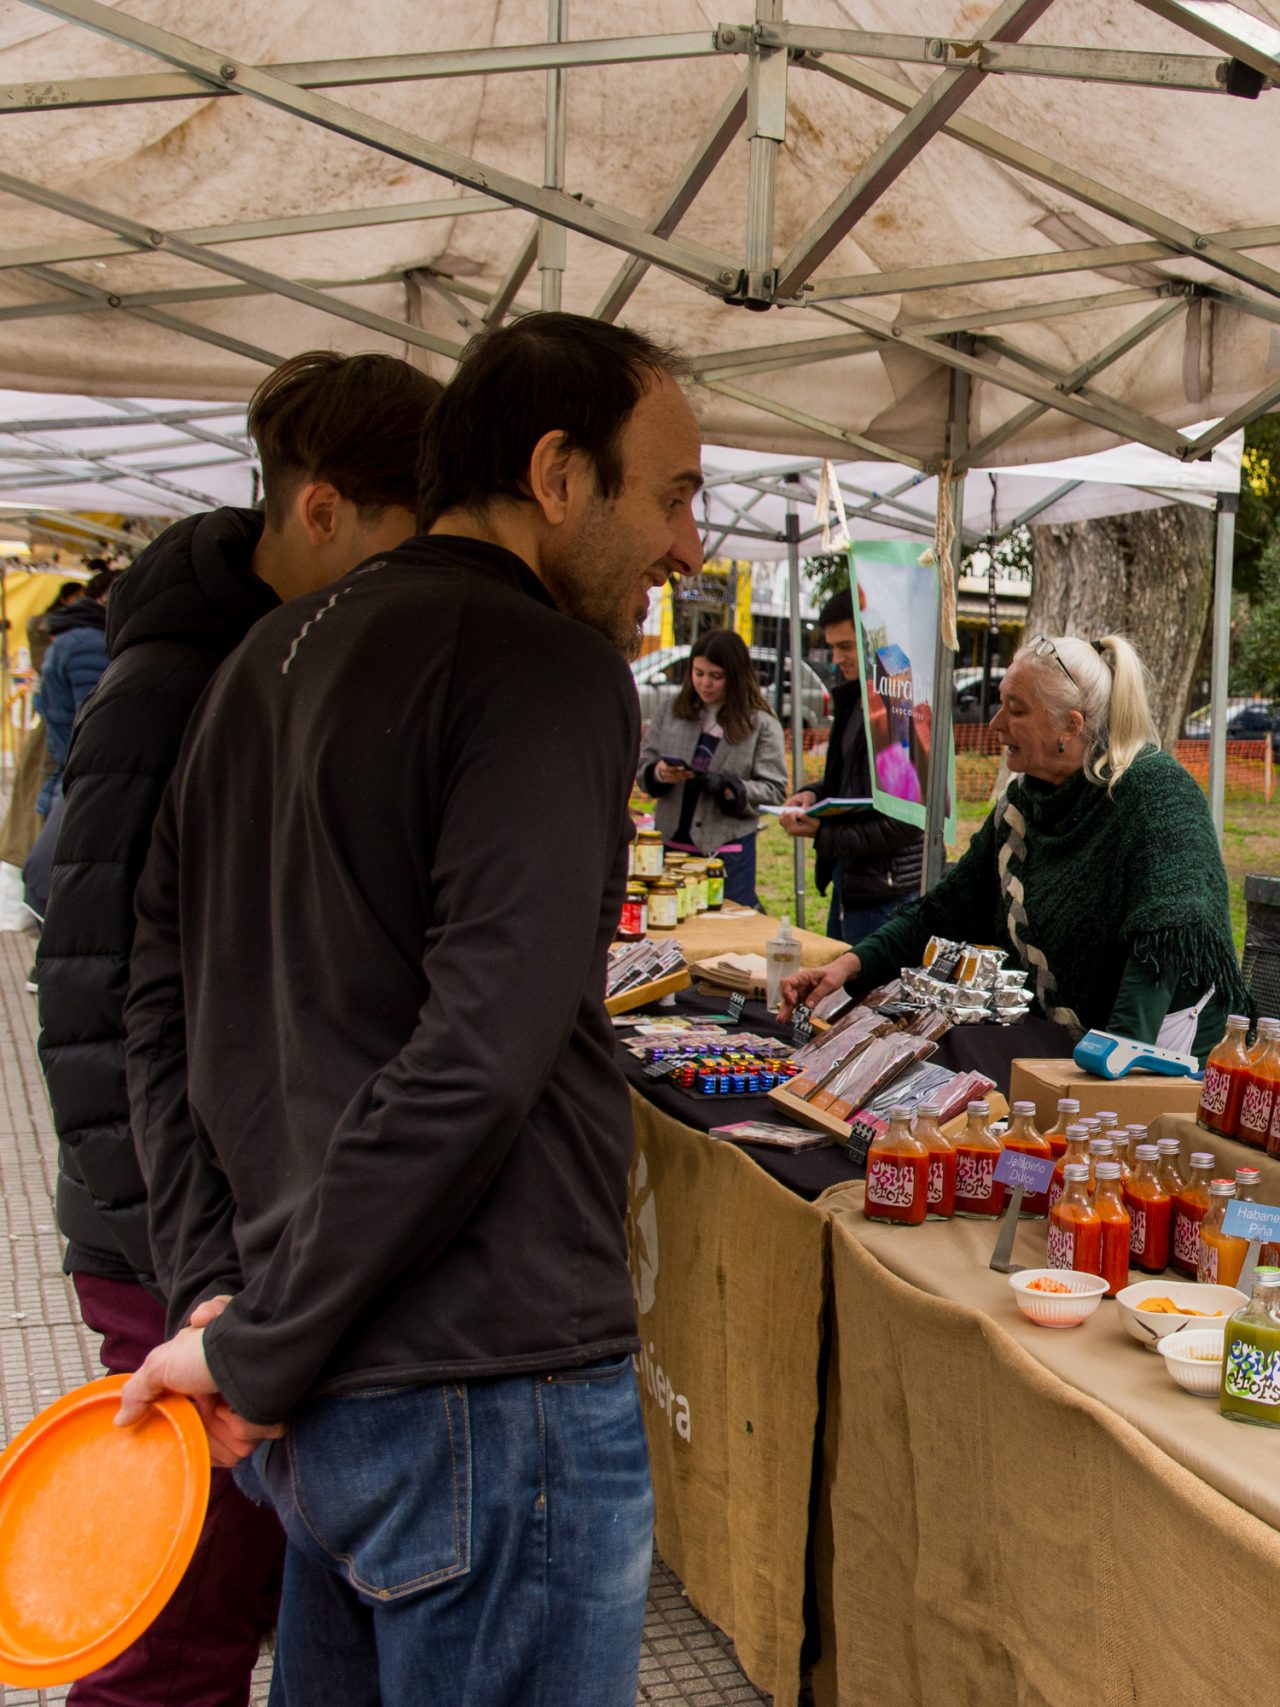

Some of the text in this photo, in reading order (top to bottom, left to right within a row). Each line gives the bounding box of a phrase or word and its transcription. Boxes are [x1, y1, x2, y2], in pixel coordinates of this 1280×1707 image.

[872, 663, 913, 701] Laura
[1009, 1169, 1036, 1185] Dulce
[1248, 1223, 1273, 1237] Piña
